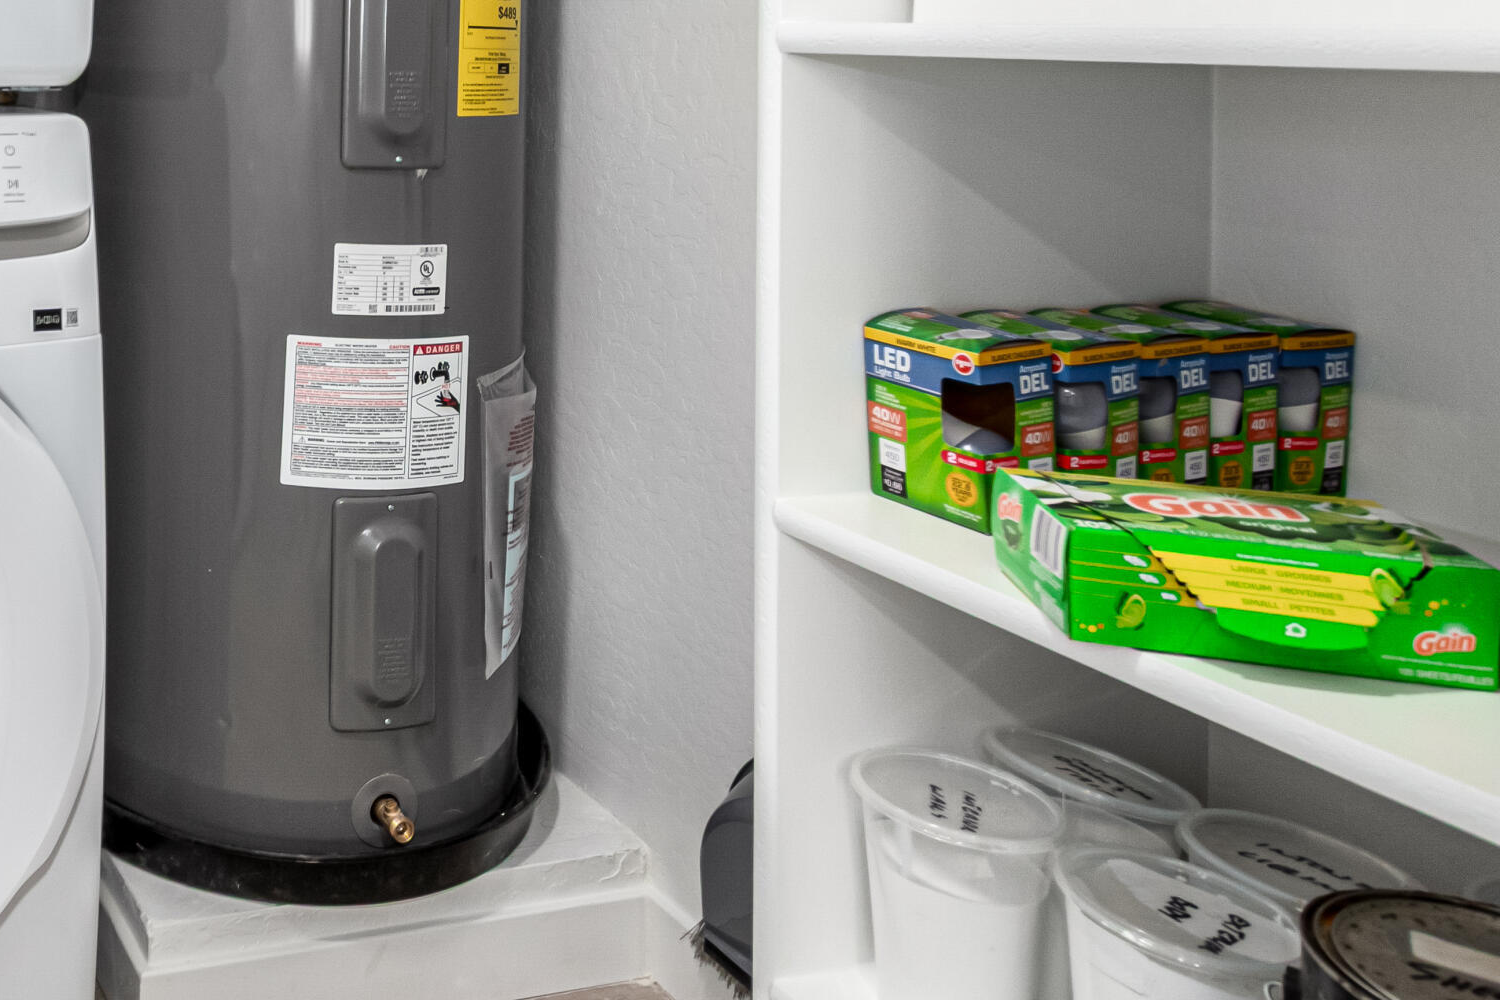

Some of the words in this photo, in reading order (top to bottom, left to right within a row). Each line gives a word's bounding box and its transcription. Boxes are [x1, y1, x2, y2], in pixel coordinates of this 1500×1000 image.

[425, 343, 461, 354] DANGER
[873, 343, 911, 373] LED
[874, 364, 893, 378] Light
[893, 370, 911, 383] Bulb
[1180, 367, 1207, 389] DEL
[1248, 362, 1275, 383] DEL
[1325, 361, 1349, 380] DEL
[1019, 371, 1050, 395] DEL
[1111, 371, 1138, 395] DEL
[872, 405, 902, 425] 40W
[1251, 416, 1276, 431] 40W
[1024, 430, 1051, 445] 40W
[1115, 430, 1136, 444] 40W
[1183, 424, 1208, 438] 40W
[1212, 443, 1220, 454] 2
[1283, 438, 1292, 449] 2
[946, 451, 958, 464] 2
[1069, 456, 1080, 468] 2
[1142, 450, 1150, 462] 2
[985, 460, 994, 472] 2
[997, 493, 1024, 522] Gain
[1124, 492, 1310, 522] Gain
[1230, 564, 1268, 576] LARGE
[1275, 570, 1332, 584] GROSSES
[1225, 579, 1273, 592] MEDIUM
[1279, 586, 1344, 601] MOYENNES
[1241, 597, 1279, 609] SMALL
[1288, 603, 1336, 617] PETITES
[1413, 630, 1477, 656] Gain
